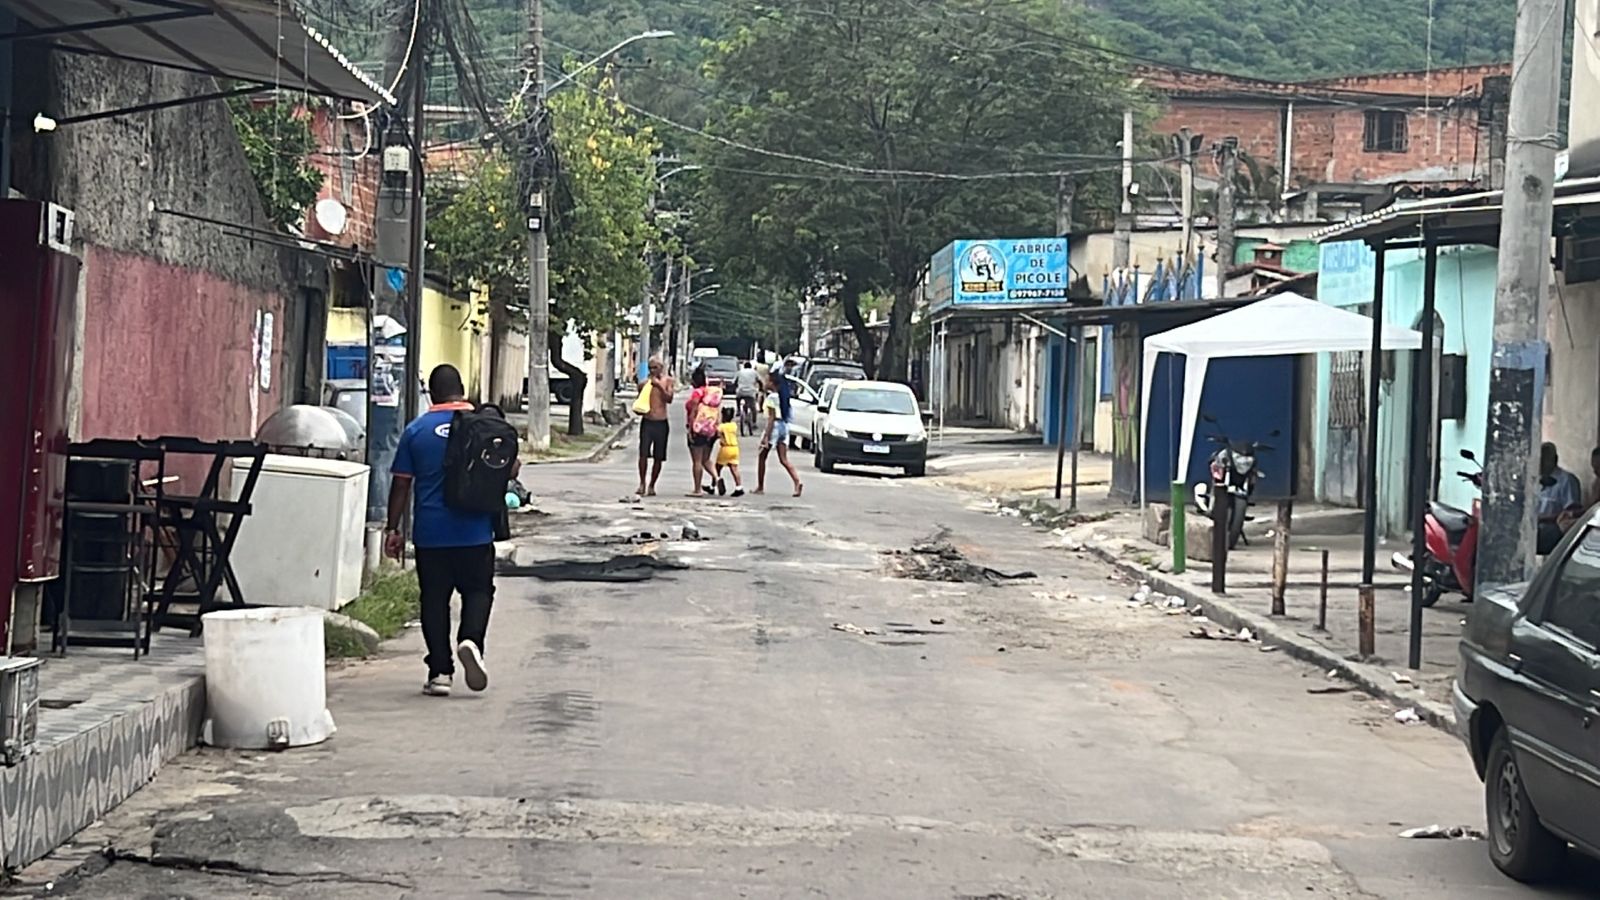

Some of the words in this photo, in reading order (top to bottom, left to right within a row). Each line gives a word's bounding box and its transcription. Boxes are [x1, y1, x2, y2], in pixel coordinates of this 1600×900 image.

[1012, 243, 1063, 254] FABRICA
[1030, 258, 1045, 268] DE
[1015, 272, 1062, 284] PICOLE
